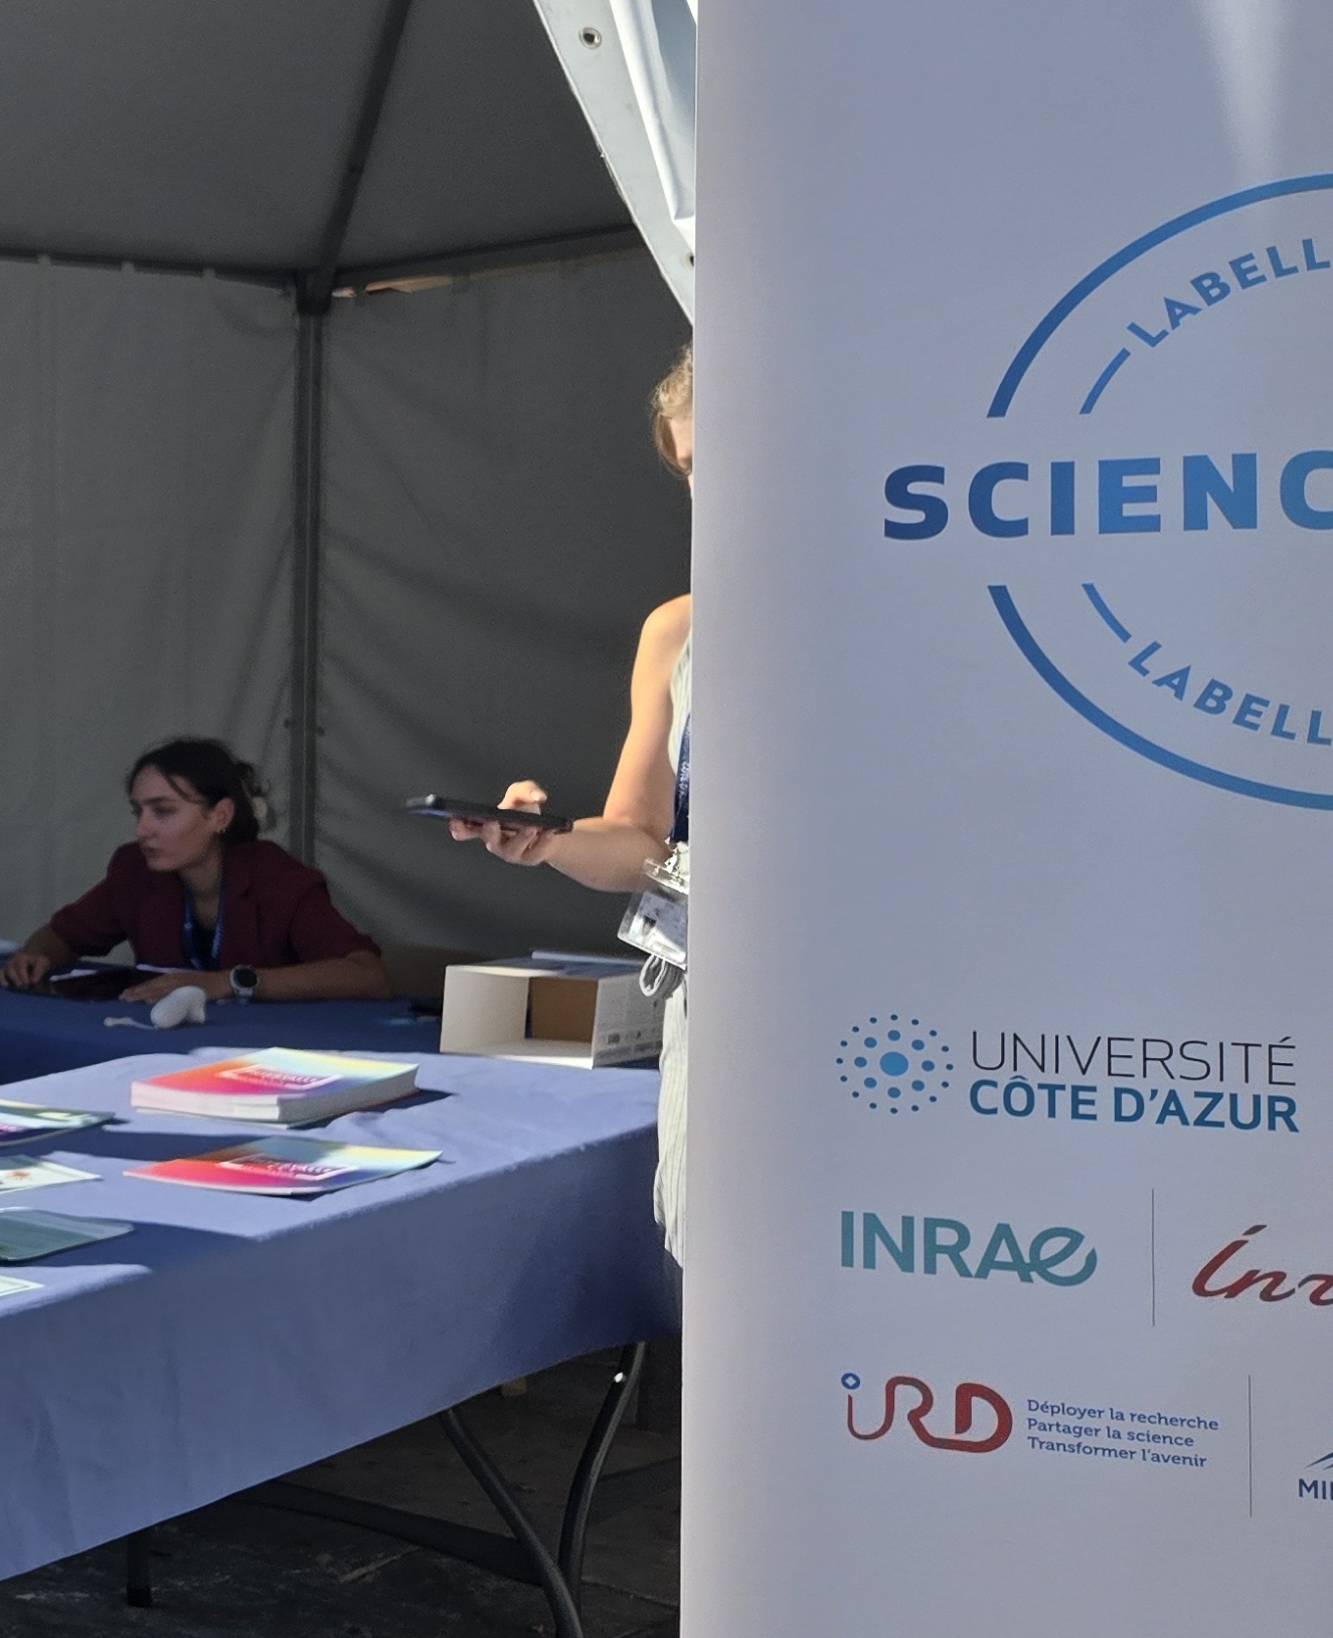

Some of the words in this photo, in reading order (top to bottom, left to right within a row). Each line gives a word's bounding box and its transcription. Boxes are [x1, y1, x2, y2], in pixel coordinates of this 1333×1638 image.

[971, 1030, 1296, 1087] UNIVERSITÉ
[969, 1075, 1098, 1121] CÔTE
[1027, 1399, 1105, 1420] Déployer
[1109, 1408, 1125, 1422] la
[1130, 1412, 1219, 1431] recherche
[1027, 1418, 1101, 1438] Partager
[1106, 1426, 1122, 1440] la
[1127, 1430, 1195, 1447] science
[1027, 1436, 1137, 1460] Transformer
[1141, 1448, 1208, 1468] l'avenir
